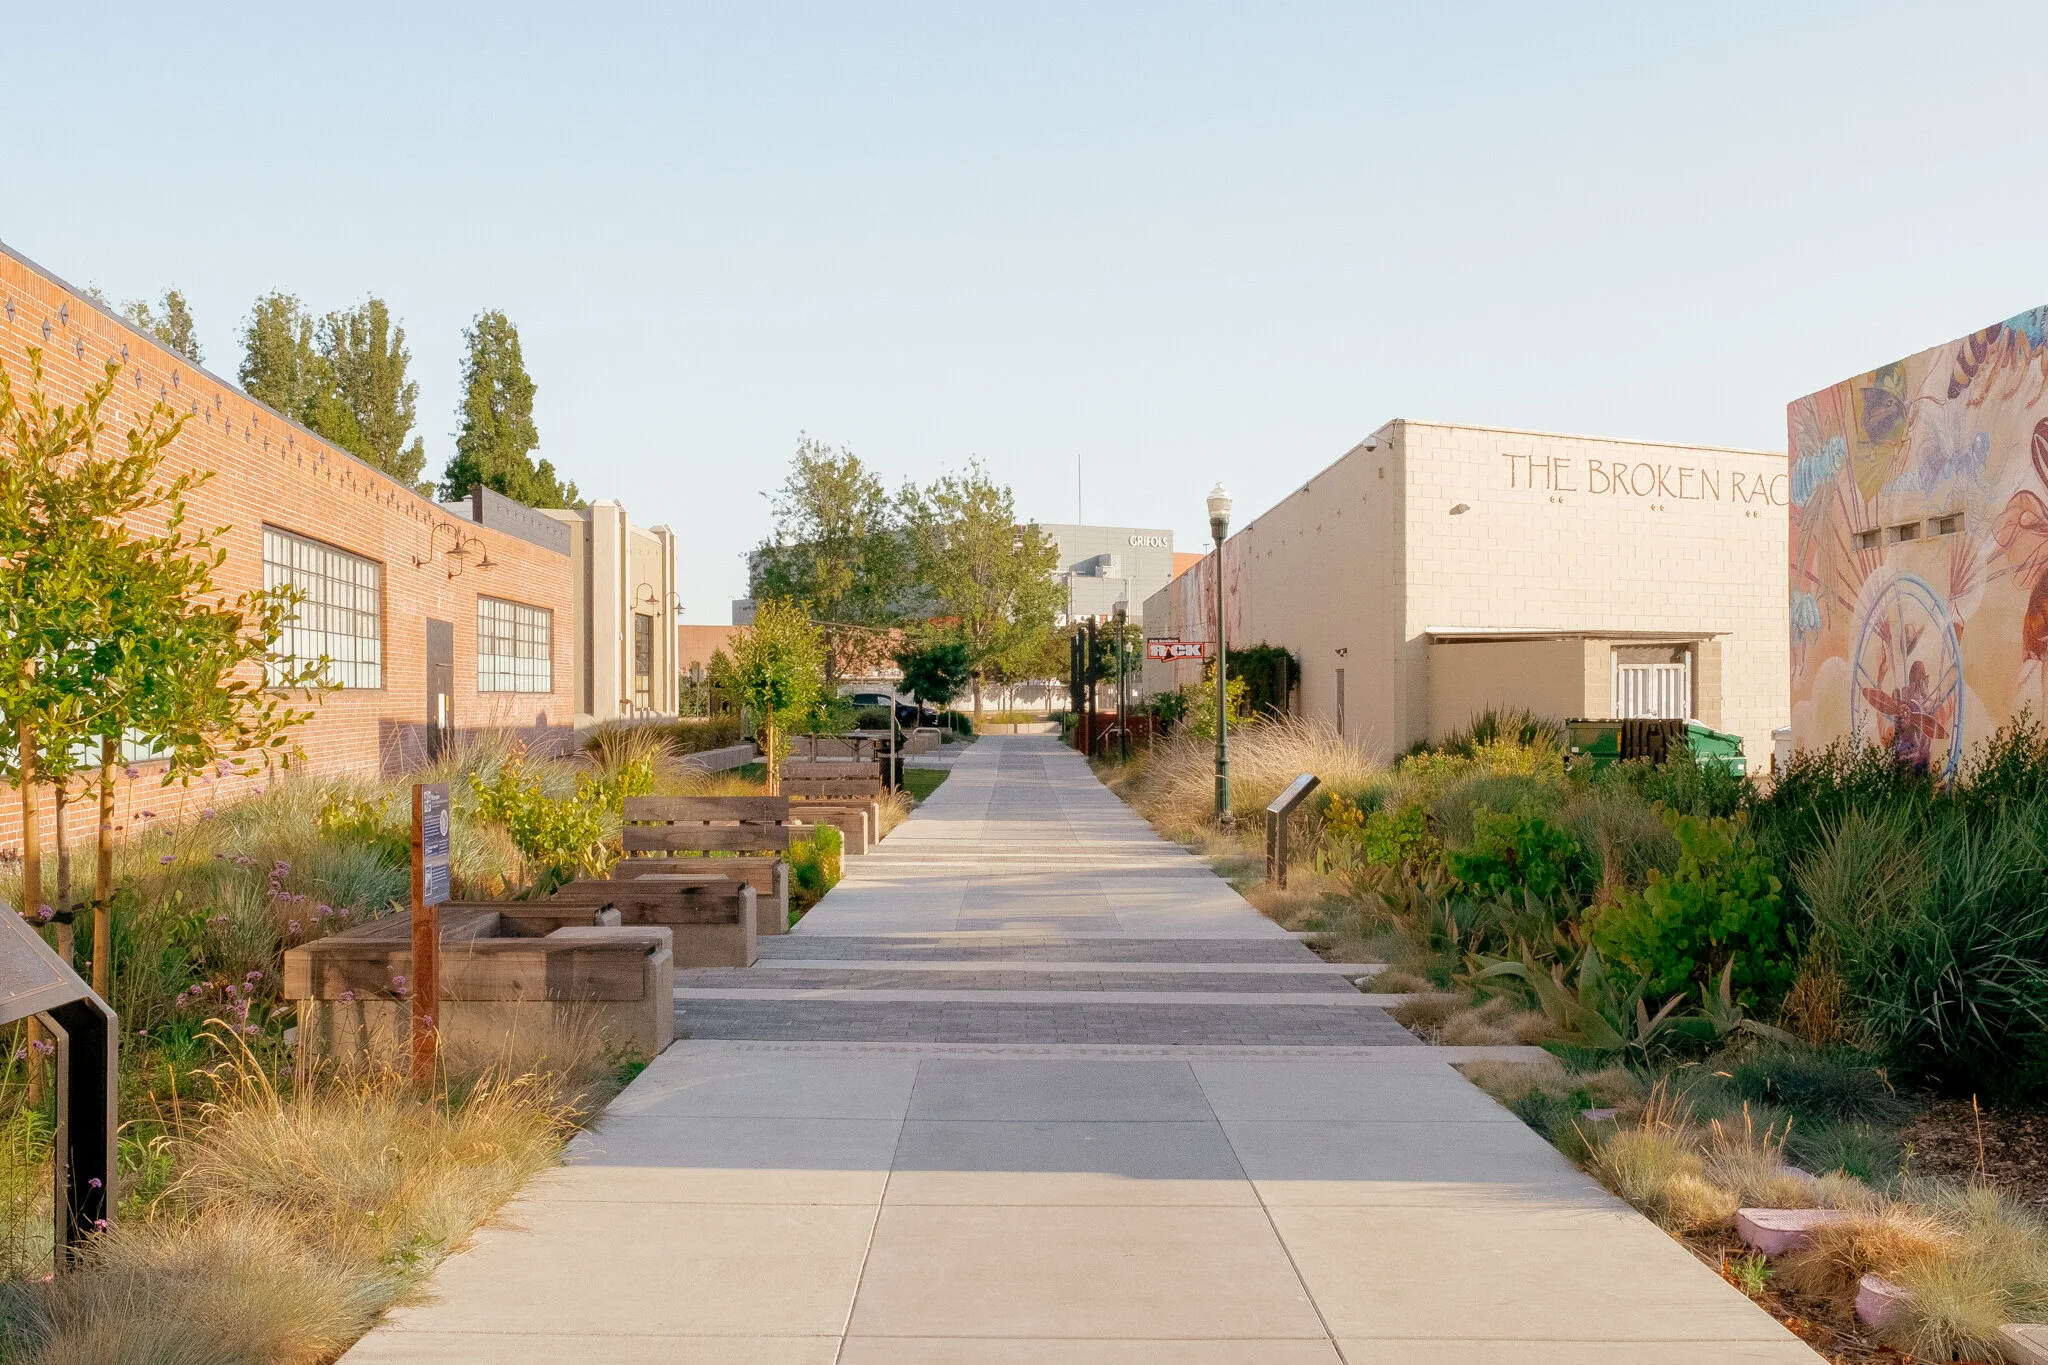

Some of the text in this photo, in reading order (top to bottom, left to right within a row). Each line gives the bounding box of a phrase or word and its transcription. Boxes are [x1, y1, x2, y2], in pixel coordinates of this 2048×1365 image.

[1502, 453, 1789, 506] THE BROKEN RAC
[1128, 535, 1168, 548] GRIFOLS
